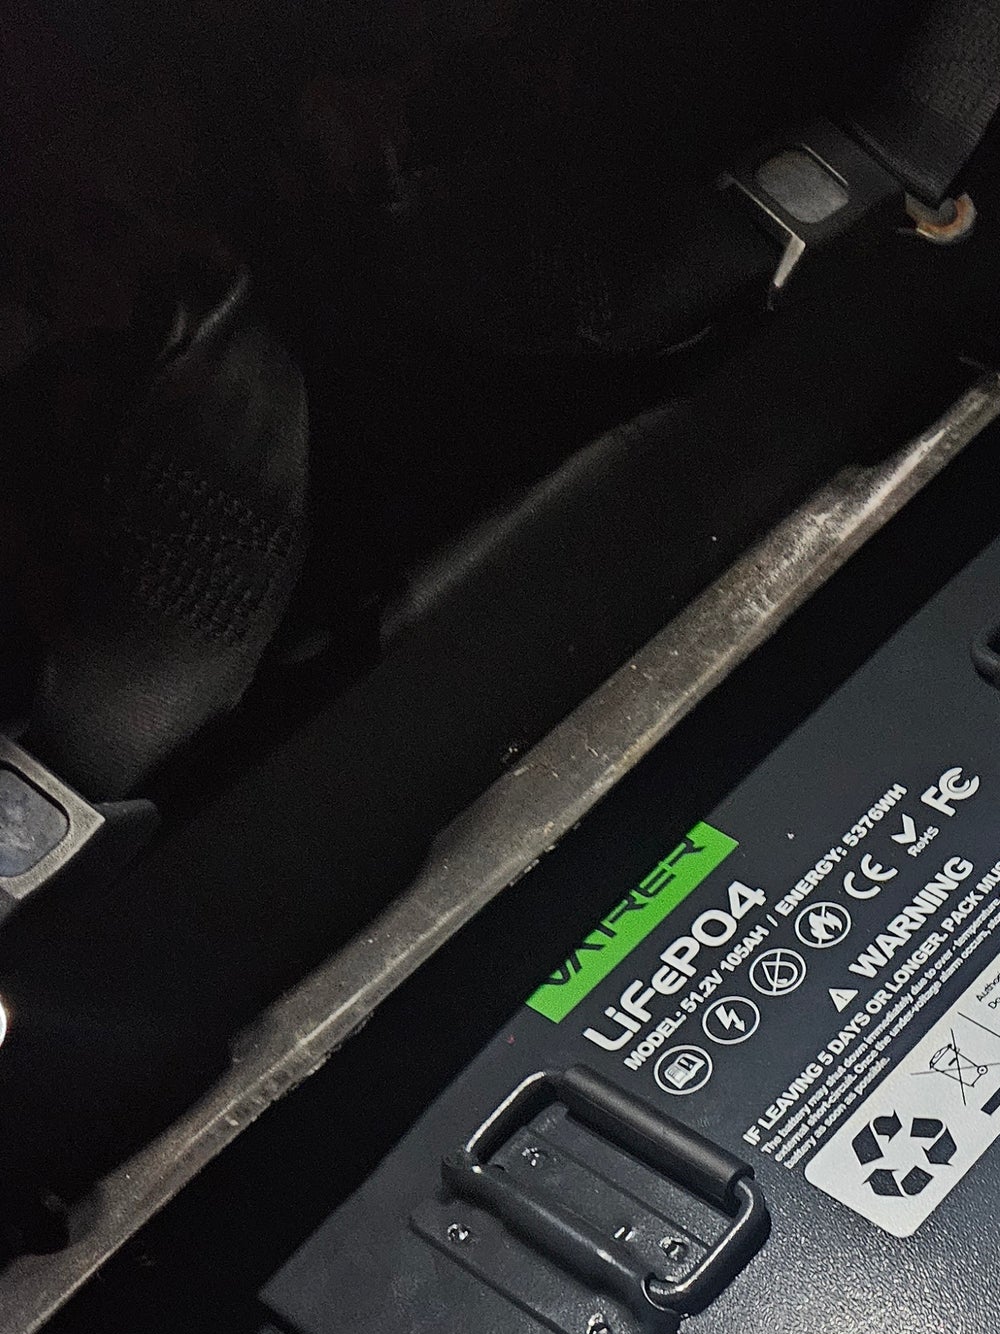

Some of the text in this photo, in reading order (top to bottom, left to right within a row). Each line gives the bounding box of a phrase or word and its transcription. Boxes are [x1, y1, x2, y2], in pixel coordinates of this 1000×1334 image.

[623, 783, 908, 1071] MODEL: 51.2V 105AH / ENERGY: 5376WH
[843, 853, 899, 900] CE
[848, 856, 974, 978] WARNING
[907, 825, 939, 858] RoHS
[582, 880, 767, 1051] LiFePO4
[742, 1125, 761, 1146] IF
[757, 1062, 824, 1131] LEAVING
[817, 1050, 834, 1066] 5
[826, 1011, 871, 1056] DAYS
[865, 989, 894, 1014] OR
[940, 890, 985, 933] PACK
[774, 1122, 810, 1162] external
[806, 1073, 858, 1127] short-circuit.
[853, 1049, 879, 1074] Once
[874, 1034, 892, 1052] the
[889, 980, 942, 1037] under-voltage
[939, 957, 964, 983] alarm
[960, 929, 992, 959] occurs,
[760, 1135, 783, 1154] The
[777, 1103, 811, 1138] battery
[807, 1084, 829, 1108] may
[825, 1065, 847, 1088] shut
[843, 1042, 869, 1068] down
[863, 992, 914, 1045] immediately
[910, 977, 928, 996] due
[923, 968, 937, 980] to
[783, 1056, 891, 1170] battery as soon as possible.
